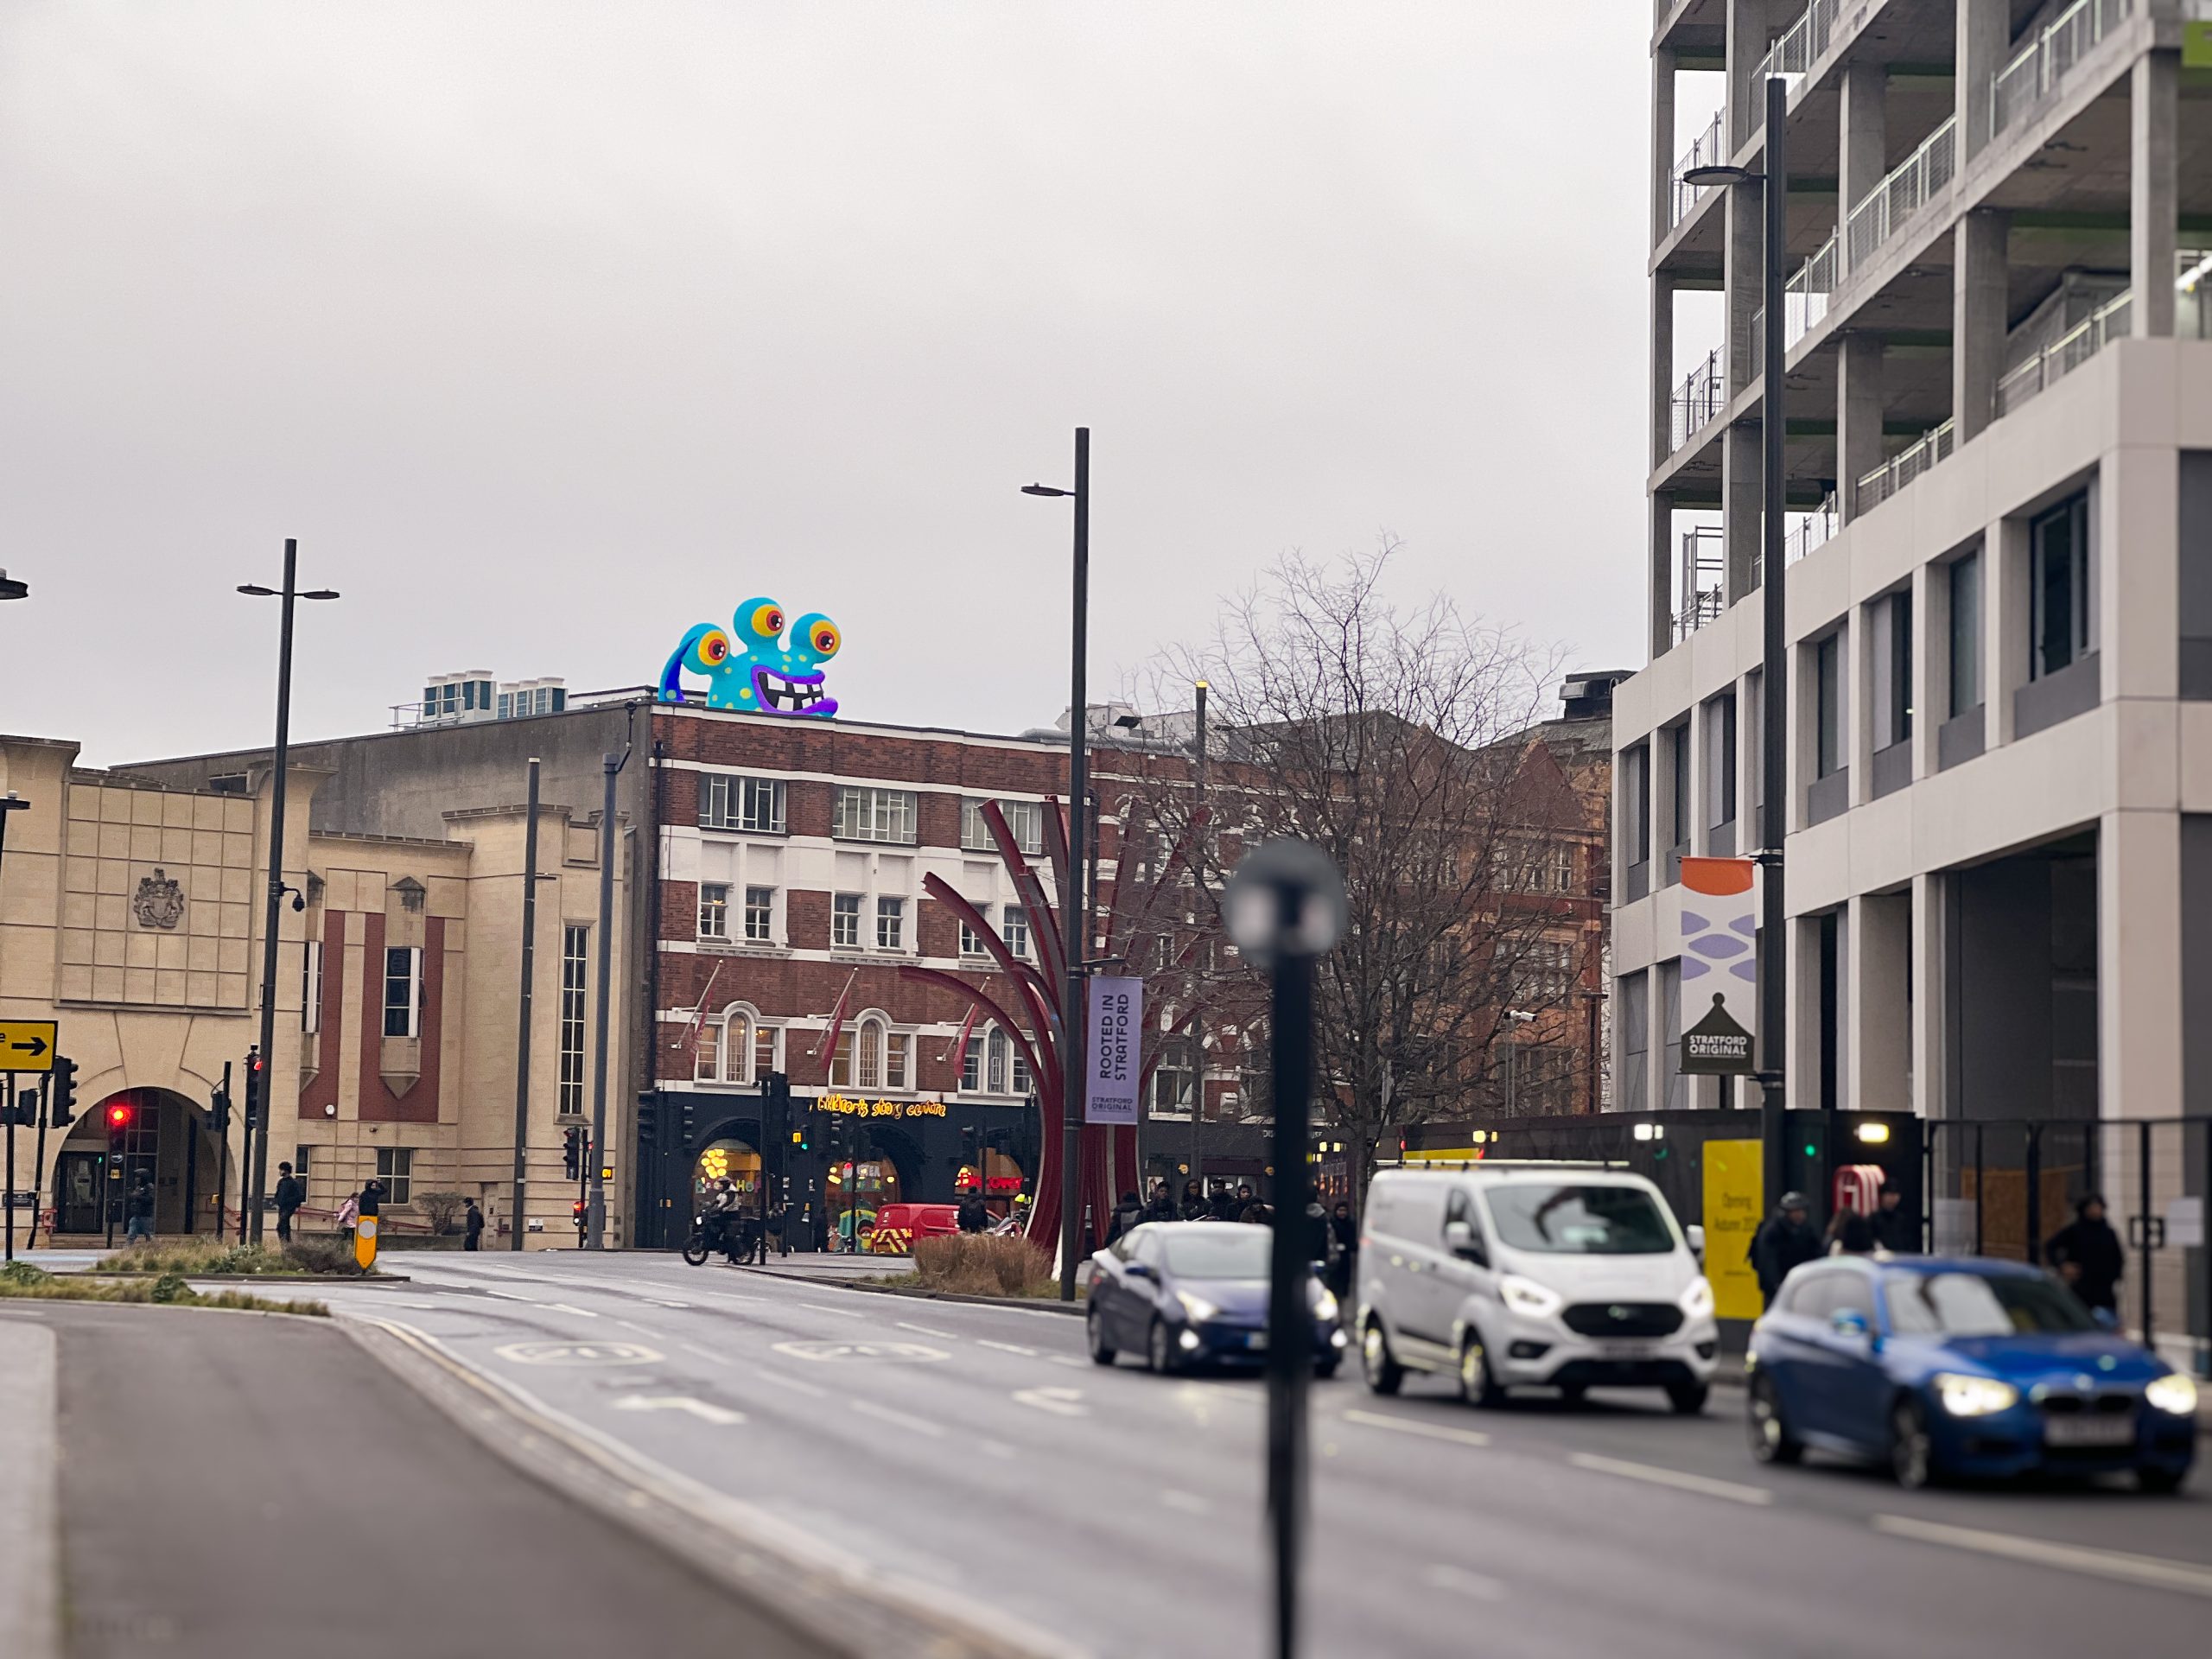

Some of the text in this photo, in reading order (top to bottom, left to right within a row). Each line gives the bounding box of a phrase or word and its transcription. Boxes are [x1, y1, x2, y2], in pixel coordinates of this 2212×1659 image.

[1100, 995, 1114, 1079] ROOTED IN
[1115, 994, 1129, 1081] STRATFORD
[1689, 1034, 1747, 1046] STRATFORD
[1689, 1044, 1747, 1055] ORIGINAL
[906, 1099, 946, 1117] centre
[1091, 1096, 1133, 1105] STRATFORD
